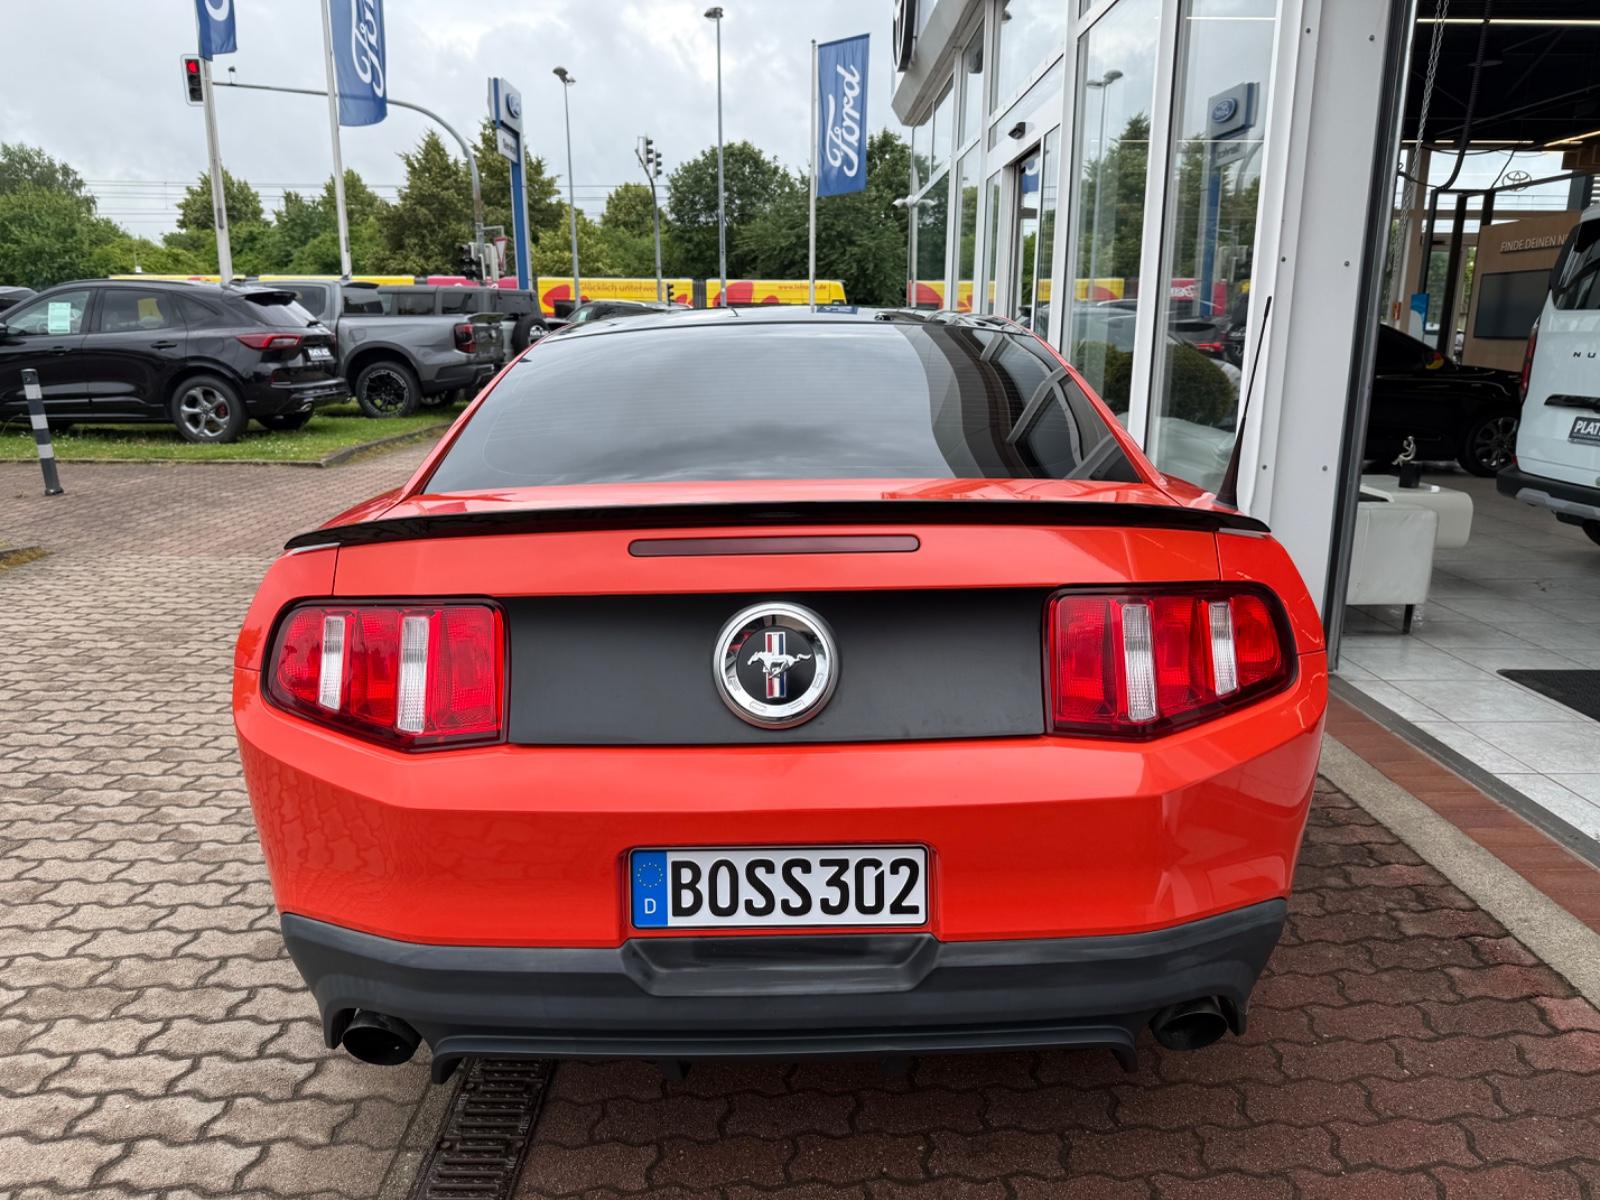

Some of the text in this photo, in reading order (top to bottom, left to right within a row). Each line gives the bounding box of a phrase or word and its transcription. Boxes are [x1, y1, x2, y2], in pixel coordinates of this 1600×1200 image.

[826, 64, 861, 178] Ford
[1500, 239, 1524, 252] FINDE
[1525, 234, 1556, 248] DEINEN
[1574, 421, 1600, 435] PLAT
[670, 857, 921, 917] BOSS302
[644, 898, 656, 913] D
